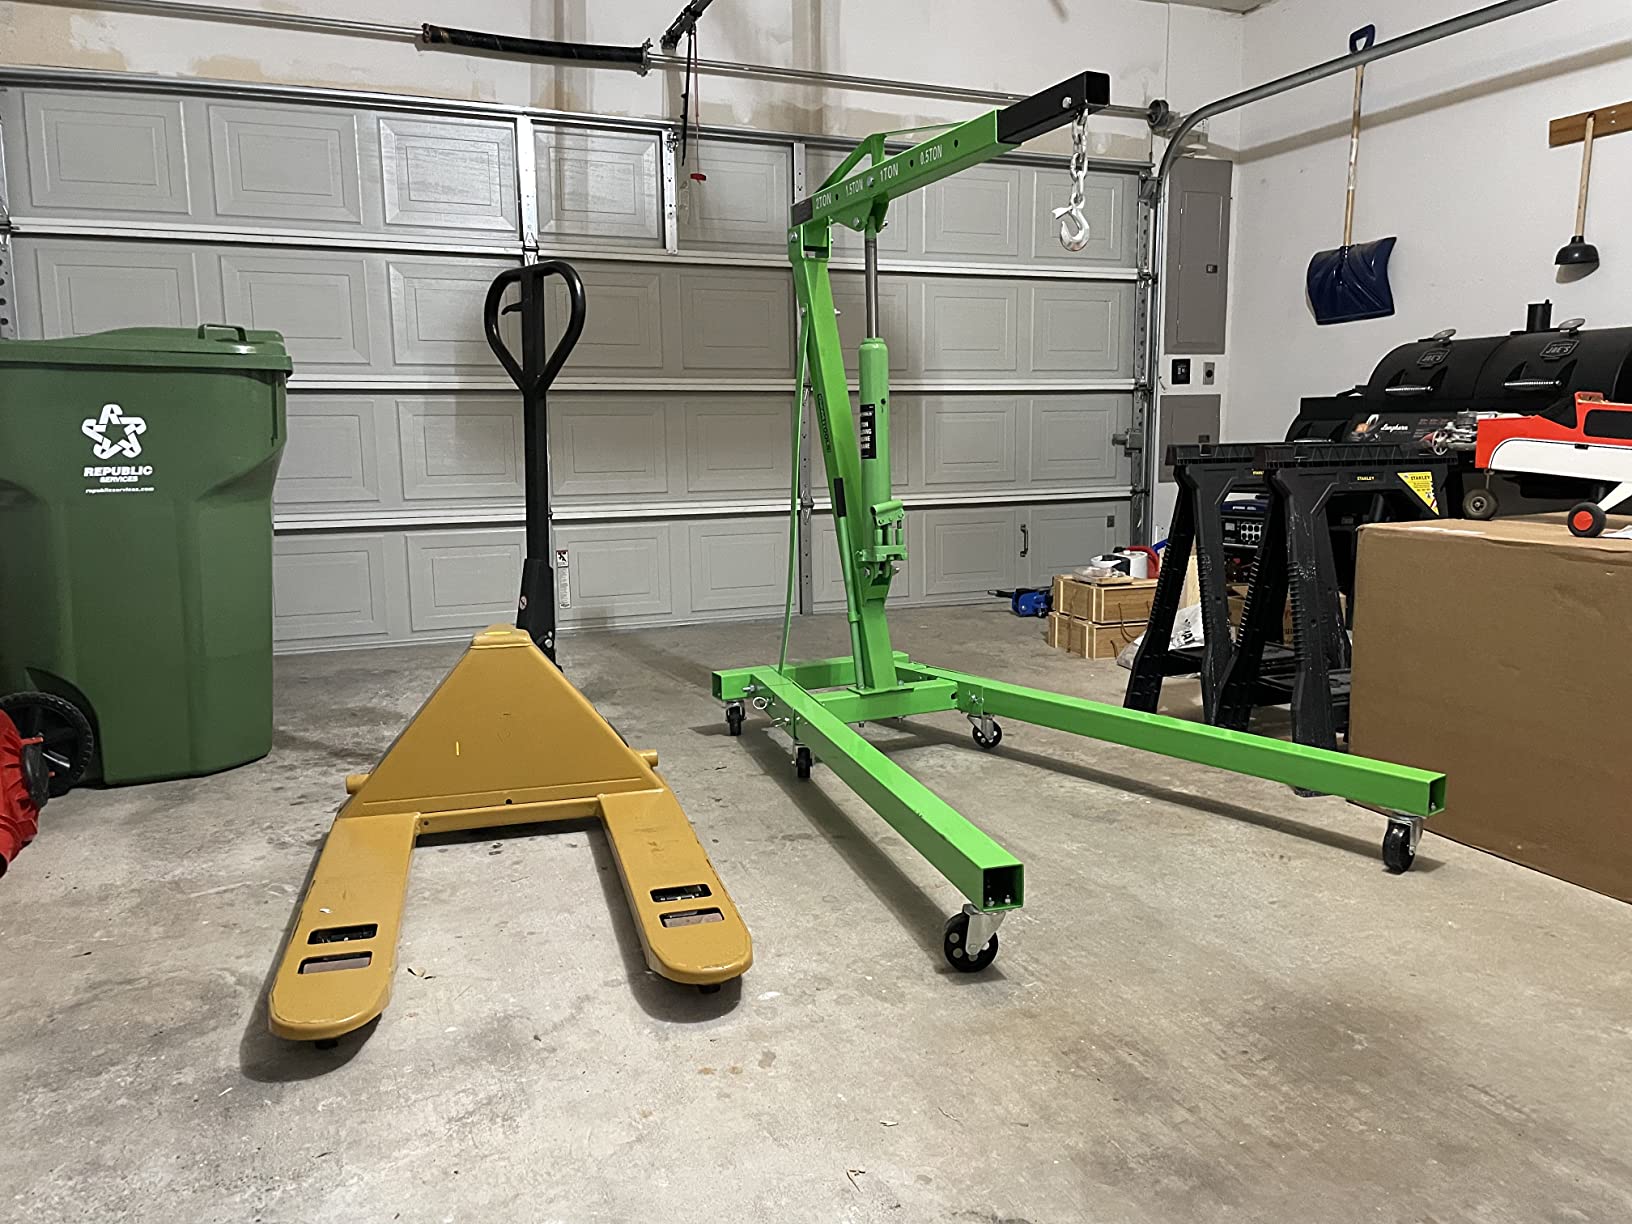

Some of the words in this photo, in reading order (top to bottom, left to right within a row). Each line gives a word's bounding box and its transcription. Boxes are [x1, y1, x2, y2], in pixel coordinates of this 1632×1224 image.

[816, 193, 832, 209] 2TON
[880, 163, 899, 182] 1TON
[920, 145, 943, 165] 0.5TON
[83, 465, 153, 477] REPUBLIC
